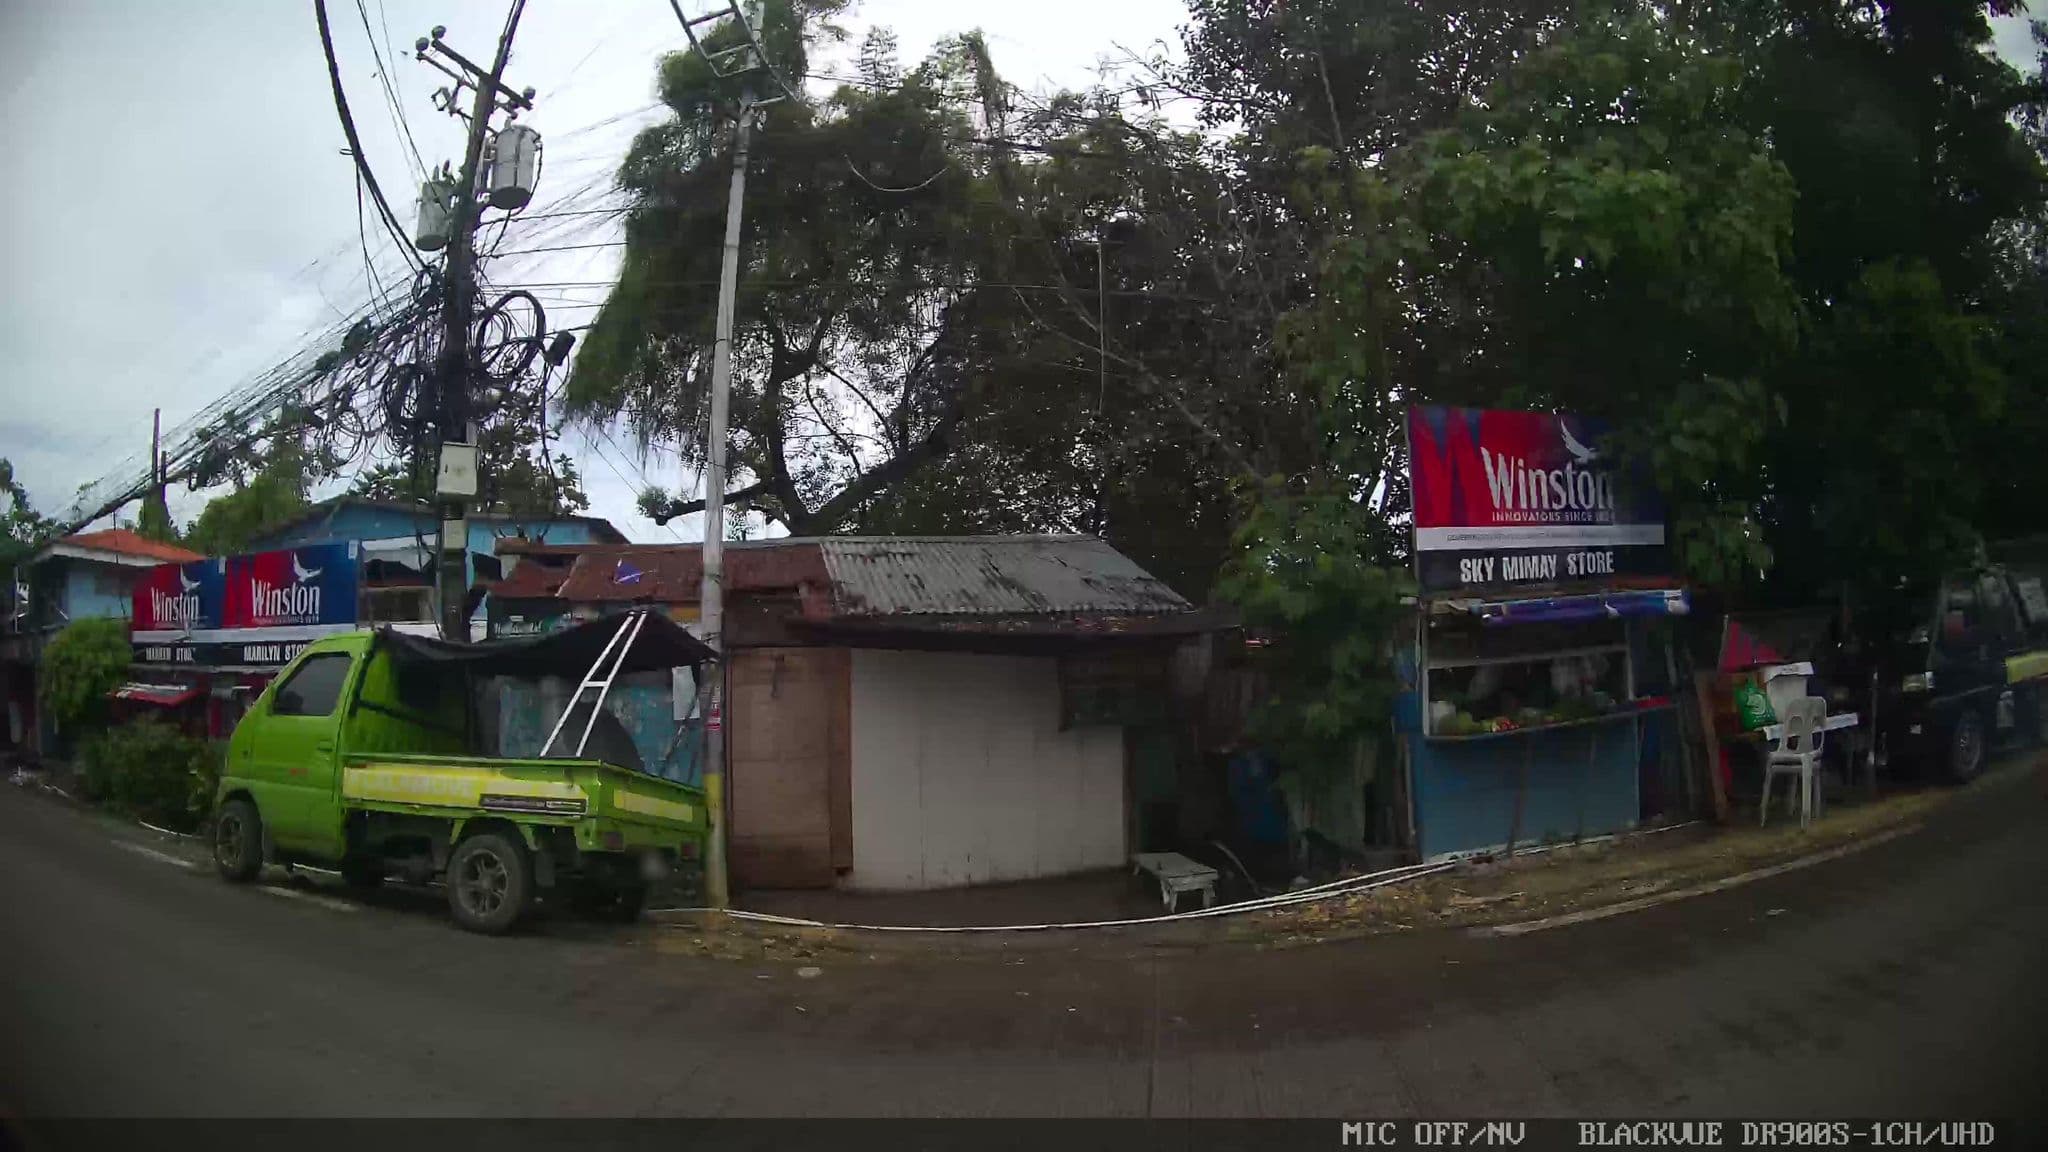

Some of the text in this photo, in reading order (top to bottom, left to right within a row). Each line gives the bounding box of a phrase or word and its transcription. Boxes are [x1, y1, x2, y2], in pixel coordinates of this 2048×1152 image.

[1481, 446, 1615, 510] Winston
[1460, 551, 1615, 583] SKY MIMAY STORE
[151, 587, 199, 622] Winston
[251, 577, 321, 617] Winston
[243, 645, 280, 662] MARILYN
